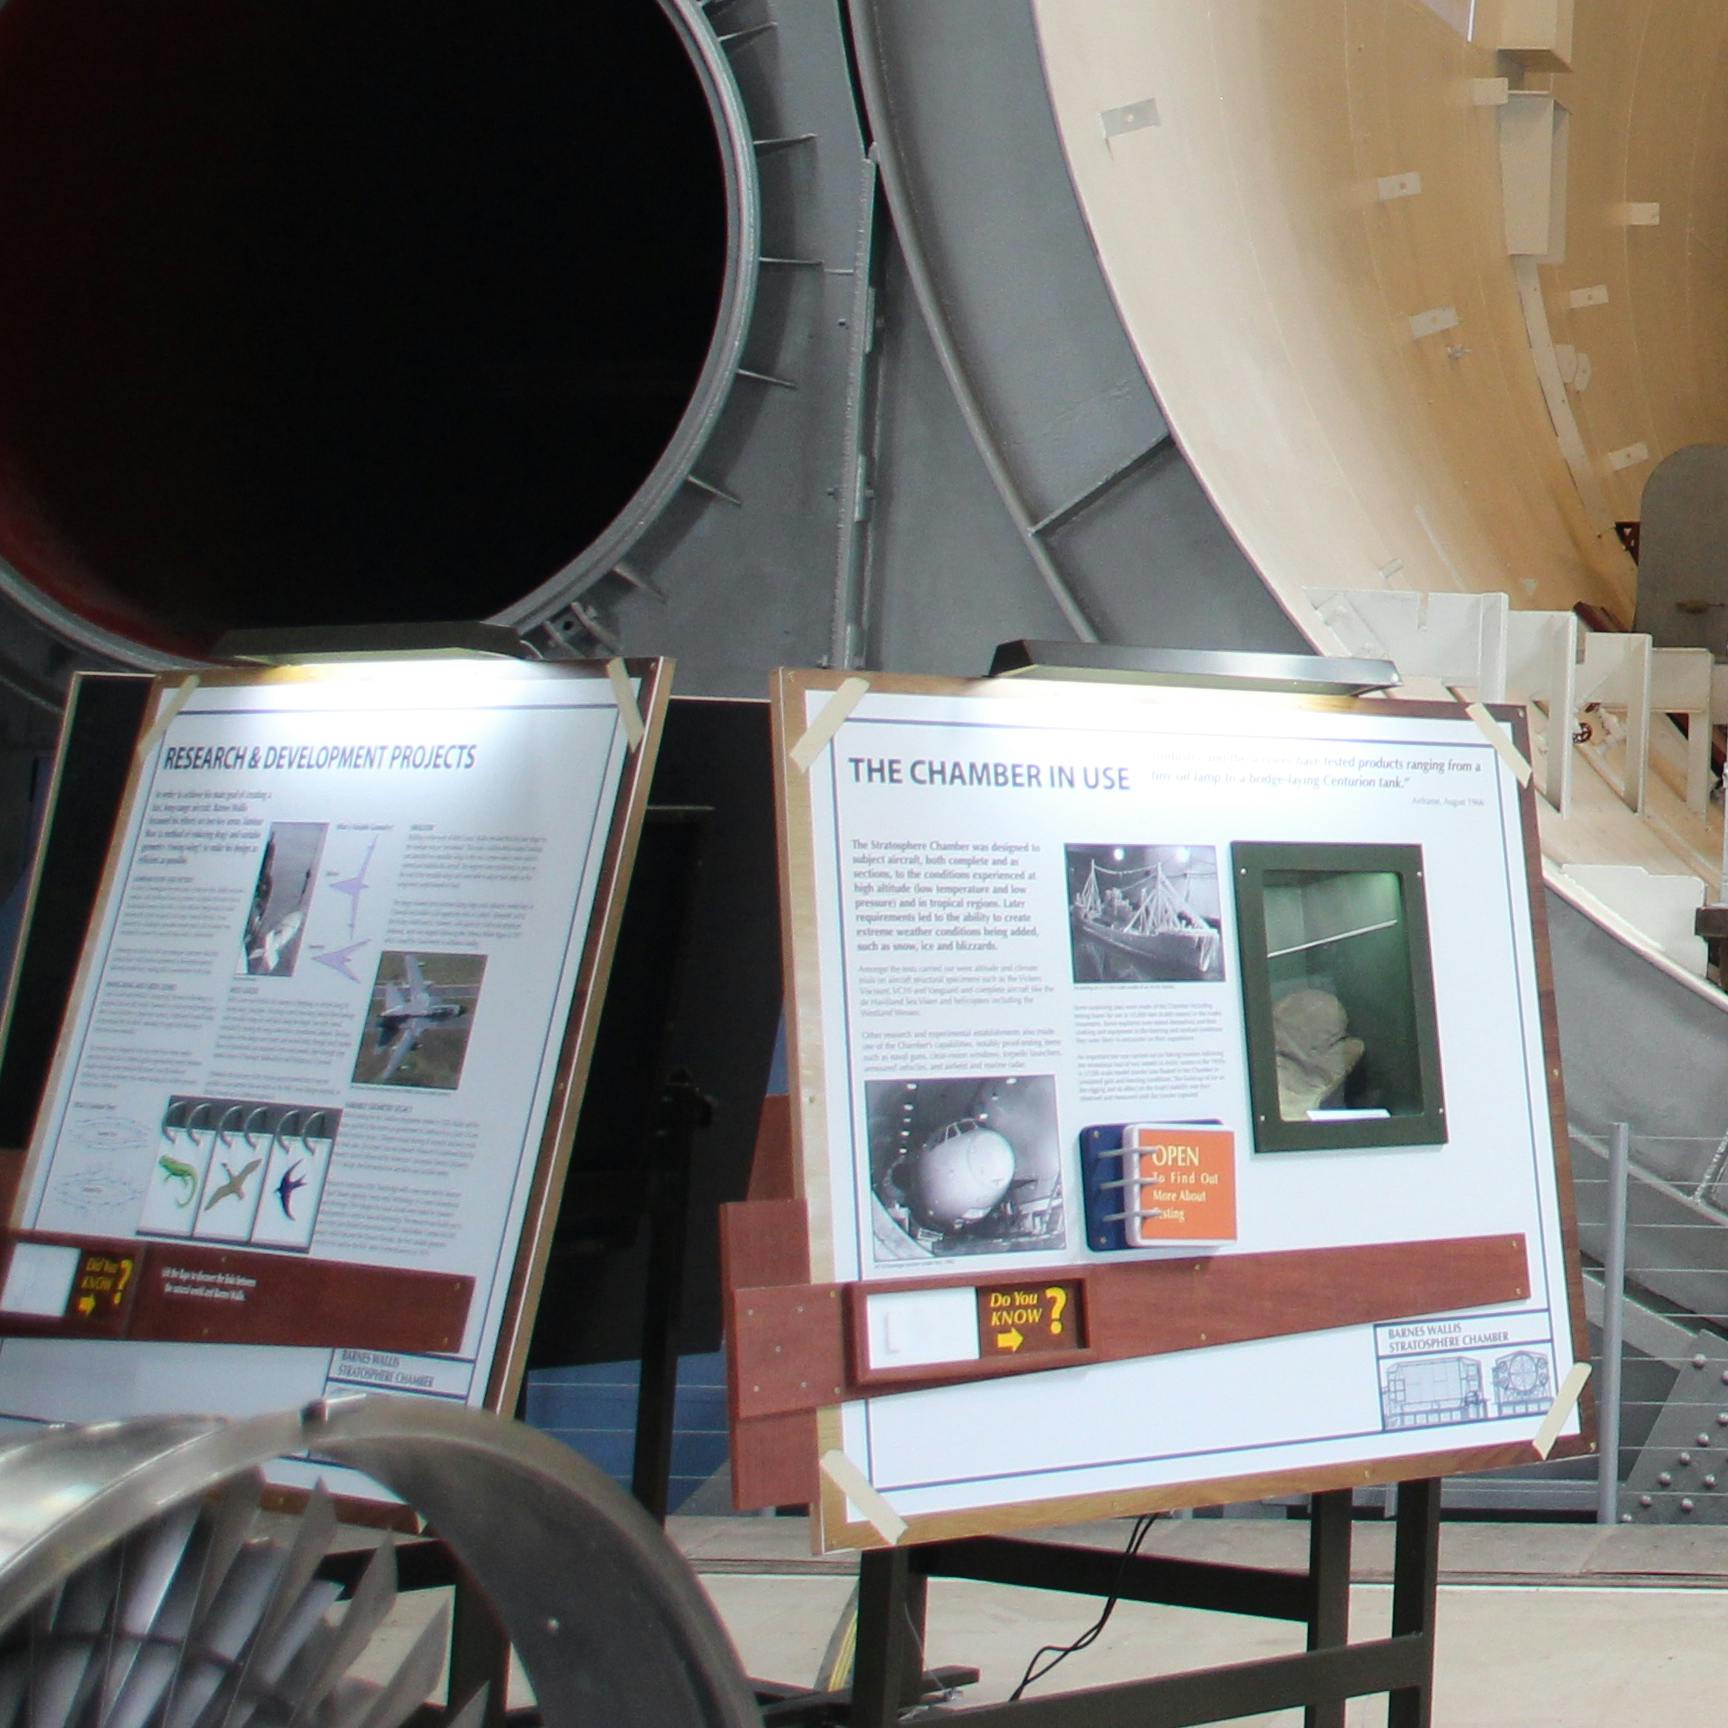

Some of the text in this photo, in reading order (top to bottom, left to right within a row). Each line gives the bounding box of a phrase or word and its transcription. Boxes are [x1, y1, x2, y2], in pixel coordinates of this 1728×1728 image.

[164, 744, 477, 770] RESEARCH & DEVELOPMENT PROJECTS
[1323, 756, 1355, 768] tested
[1358, 757, 1403, 773] products
[1406, 759, 1445, 774] ranging
[1448, 759, 1472, 771] from
[1475, 763, 1481, 771] a
[849, 757, 1131, 790] THE CHAMBER IN USE
[1194, 770, 1221, 784] lamp
[1225, 773, 1236, 783] to
[1249, 773, 1320, 788] bridge-laying
[1323, 775, 1376, 787] Centurion
[1152, 1145, 1199, 1166] OPEN
[1171, 1172, 1195, 1183] Find
[1201, 1173, 1219, 1185] Out
[1153, 1190, 1206, 1202] More About
[990, 1291, 1038, 1307] Do You
[992, 1308, 1042, 1326] KNOW
[1045, 1286, 1067, 1335] ?
[1388, 1322, 1462, 1339] BARNES WALLIS
[1389, 1331, 1509, 1352] STRATOSPHERE CHAMBER
[343, 1350, 400, 1367] BARNES WALLIS
[338, 1364, 434, 1387] STRATOSPHERE CHAMBER
